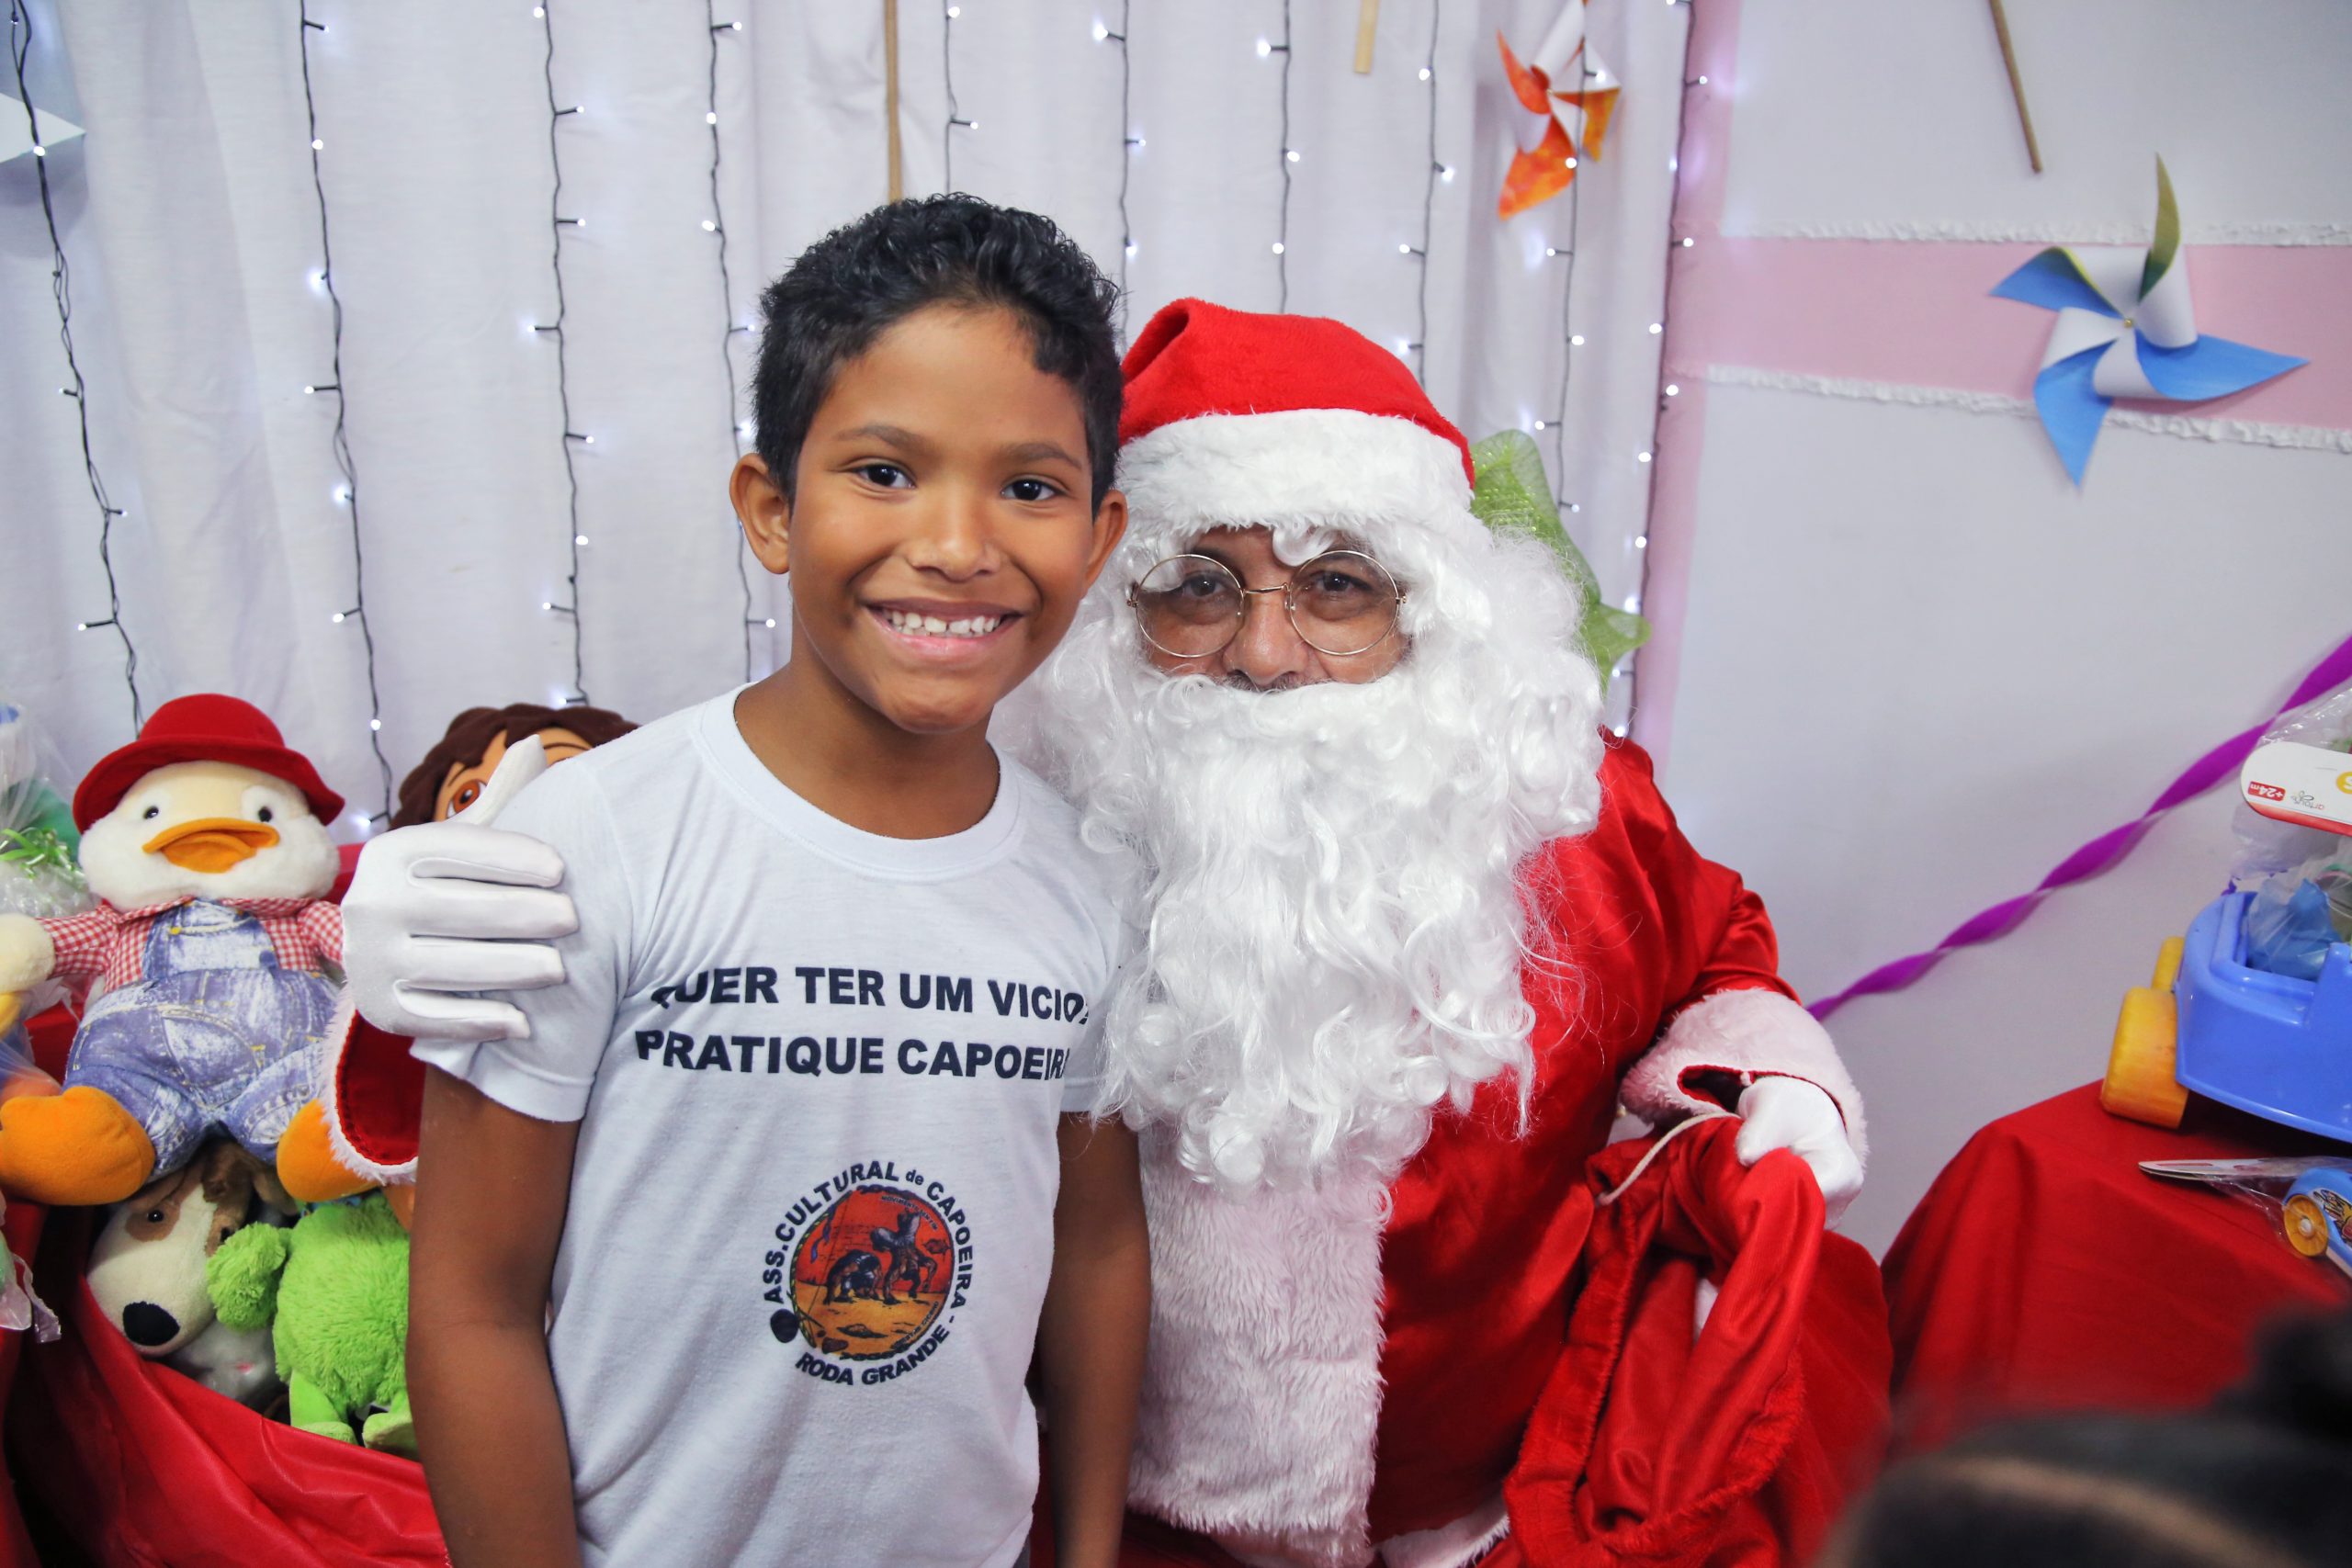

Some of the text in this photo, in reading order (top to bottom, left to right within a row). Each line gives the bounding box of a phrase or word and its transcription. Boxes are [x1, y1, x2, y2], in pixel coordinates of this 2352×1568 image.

[795, 966, 886, 1007] TER
[899, 973, 973, 1013] UM
[635, 1030, 884, 1077] PRATIQUE
[905, 1168, 924, 1185] de
[926, 1181, 973, 1310] CAPOEIRA
[795, 1351, 854, 1386] RODA
[861, 1324, 950, 1386] GRANDE
